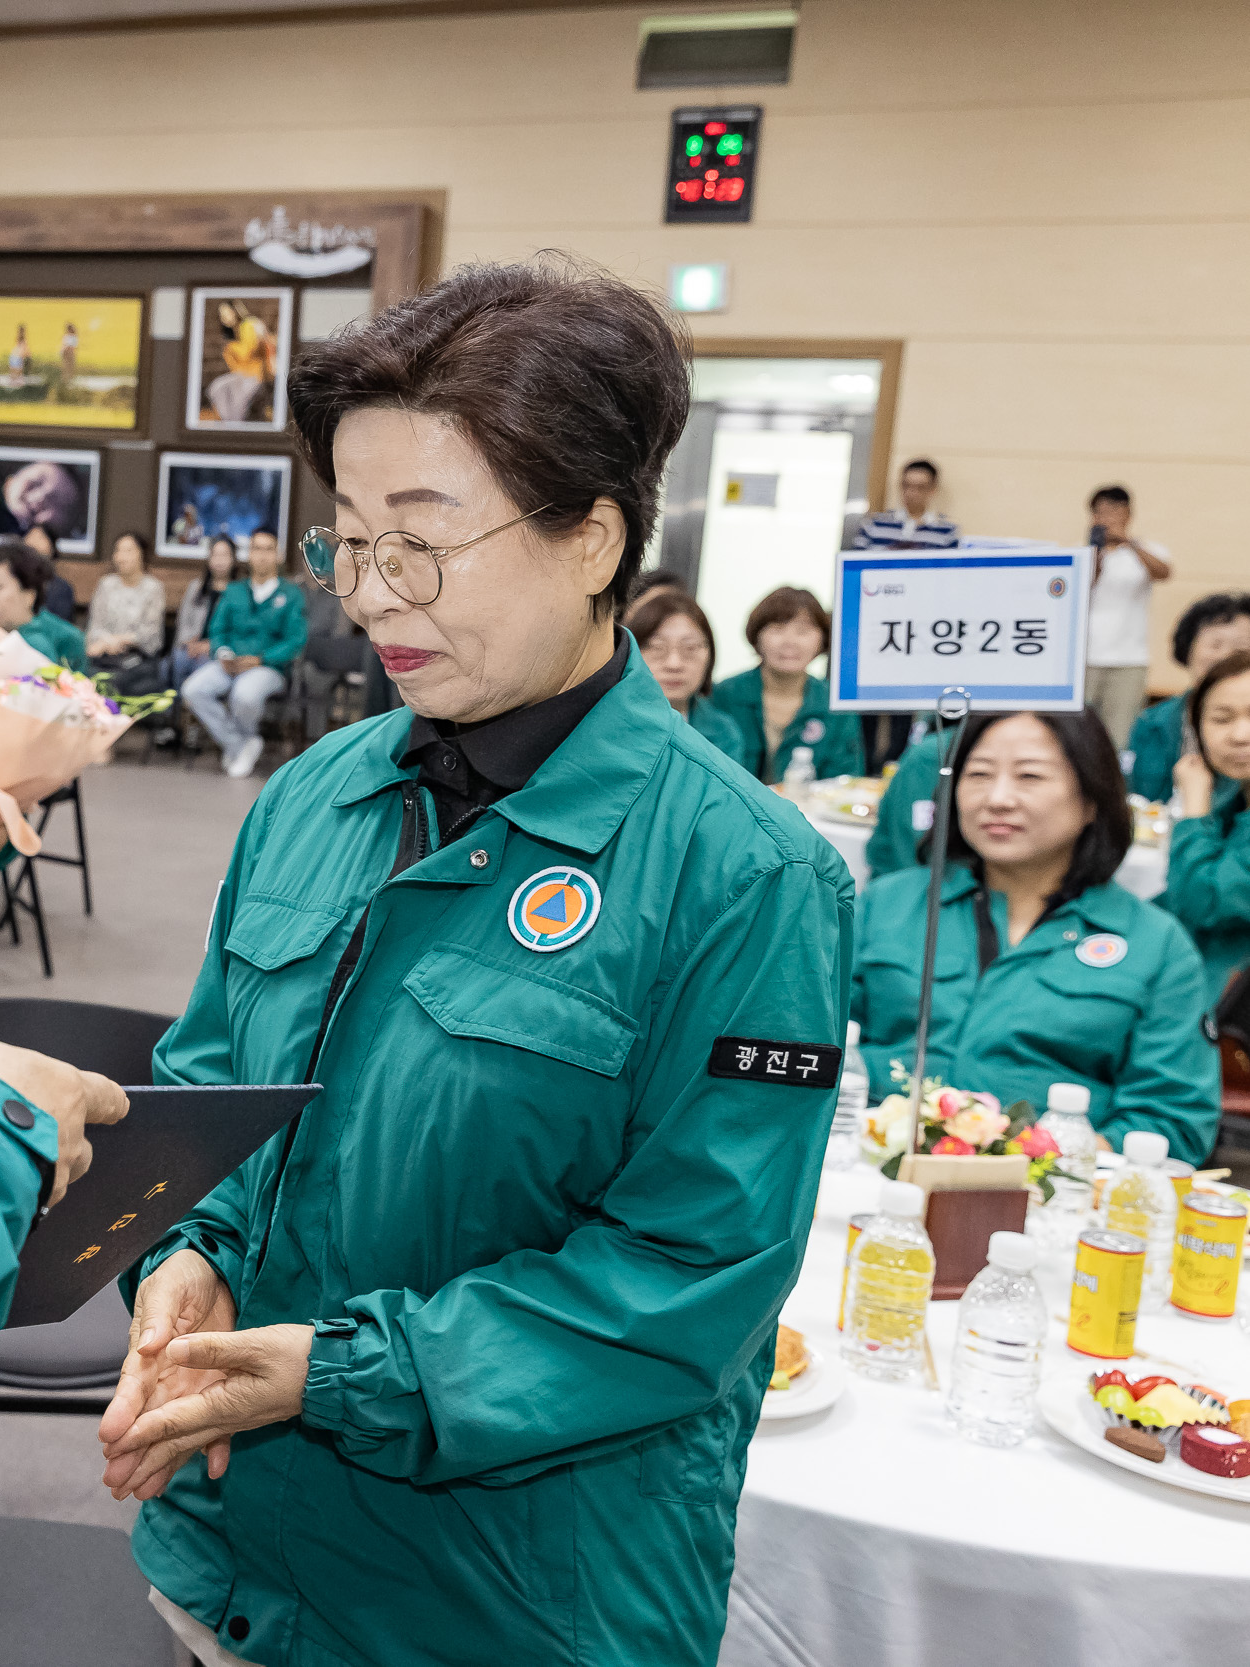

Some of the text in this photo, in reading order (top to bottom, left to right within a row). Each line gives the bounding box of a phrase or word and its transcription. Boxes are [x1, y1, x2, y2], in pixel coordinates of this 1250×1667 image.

[879, 619, 1049, 656] 자양2동
[735, 1045, 819, 1079] 광진구
[72, 1180, 169, 1264] 광진구
